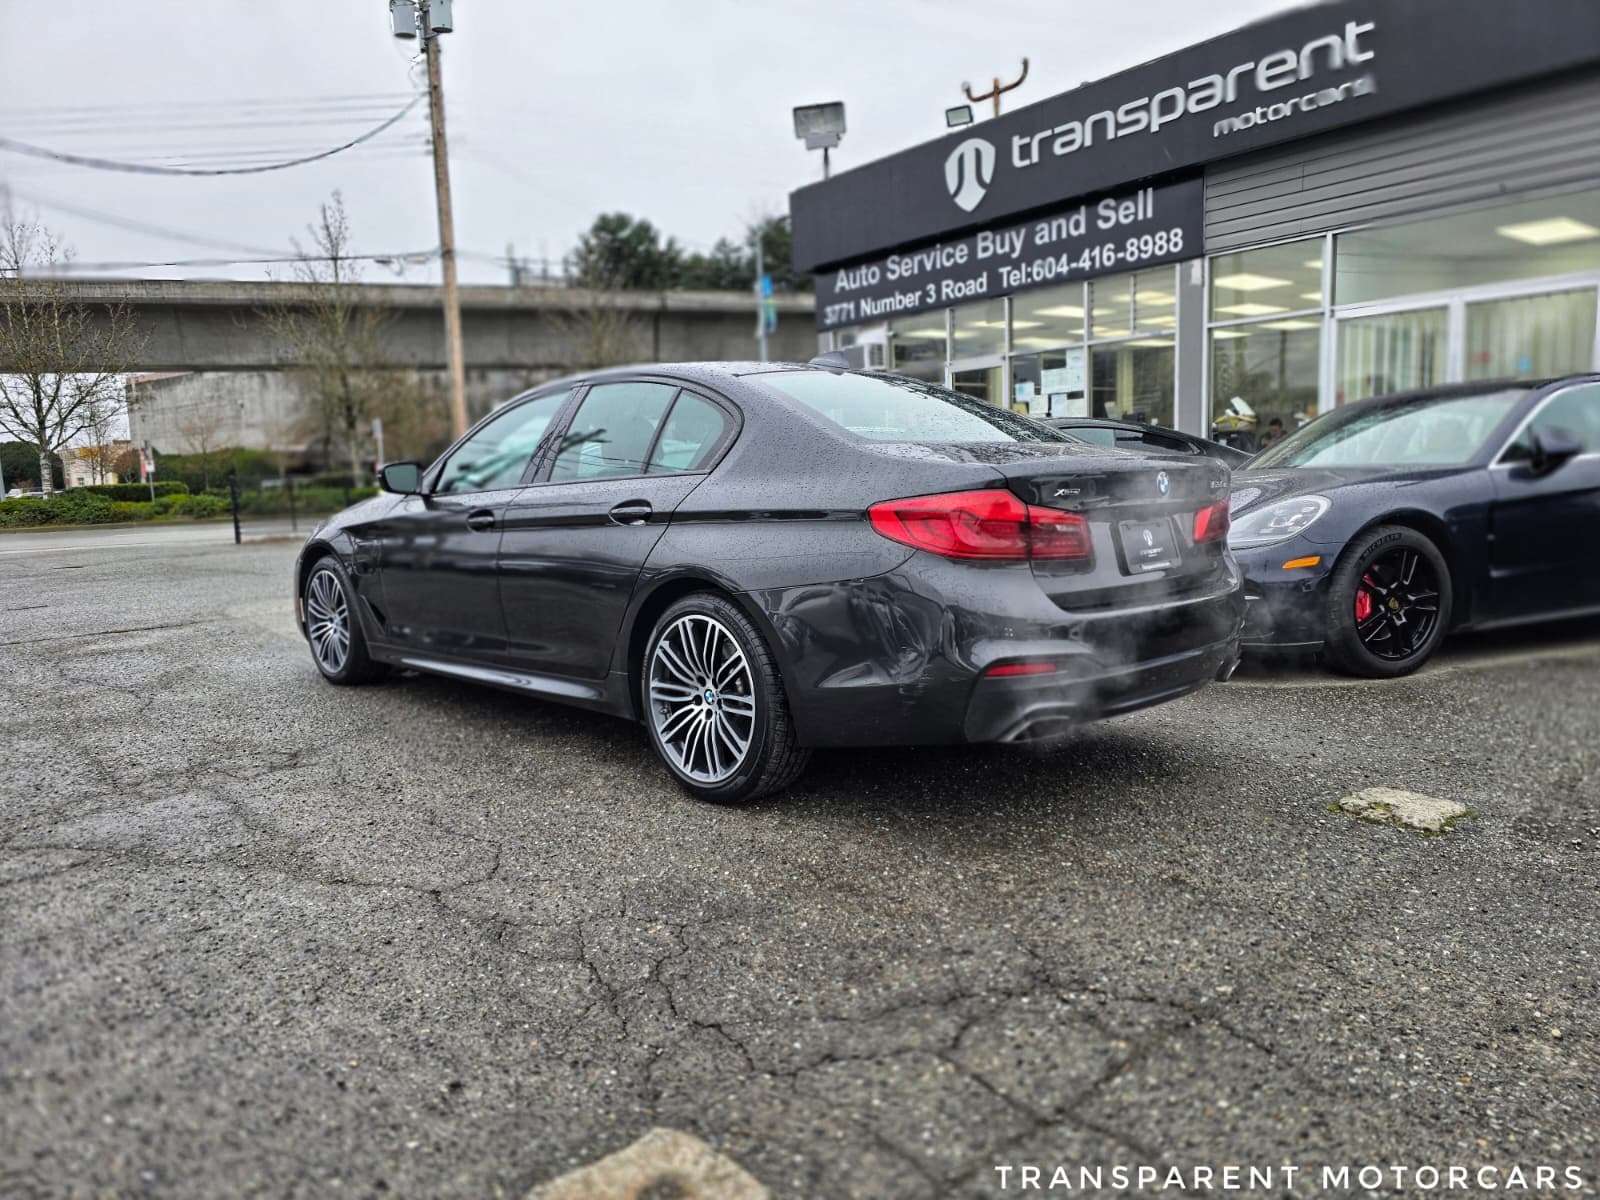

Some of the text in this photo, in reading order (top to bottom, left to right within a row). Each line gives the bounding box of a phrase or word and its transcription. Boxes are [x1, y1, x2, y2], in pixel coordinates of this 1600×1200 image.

[1011, 21, 1375, 168] transparent
[834, 187, 1153, 293] Auto Service Buy and Sell
[859, 289, 922, 317] Number
[925, 283, 936, 304] 3
[941, 271, 988, 301] Road
[998, 227, 1183, 289] Tel:604-416-8988
